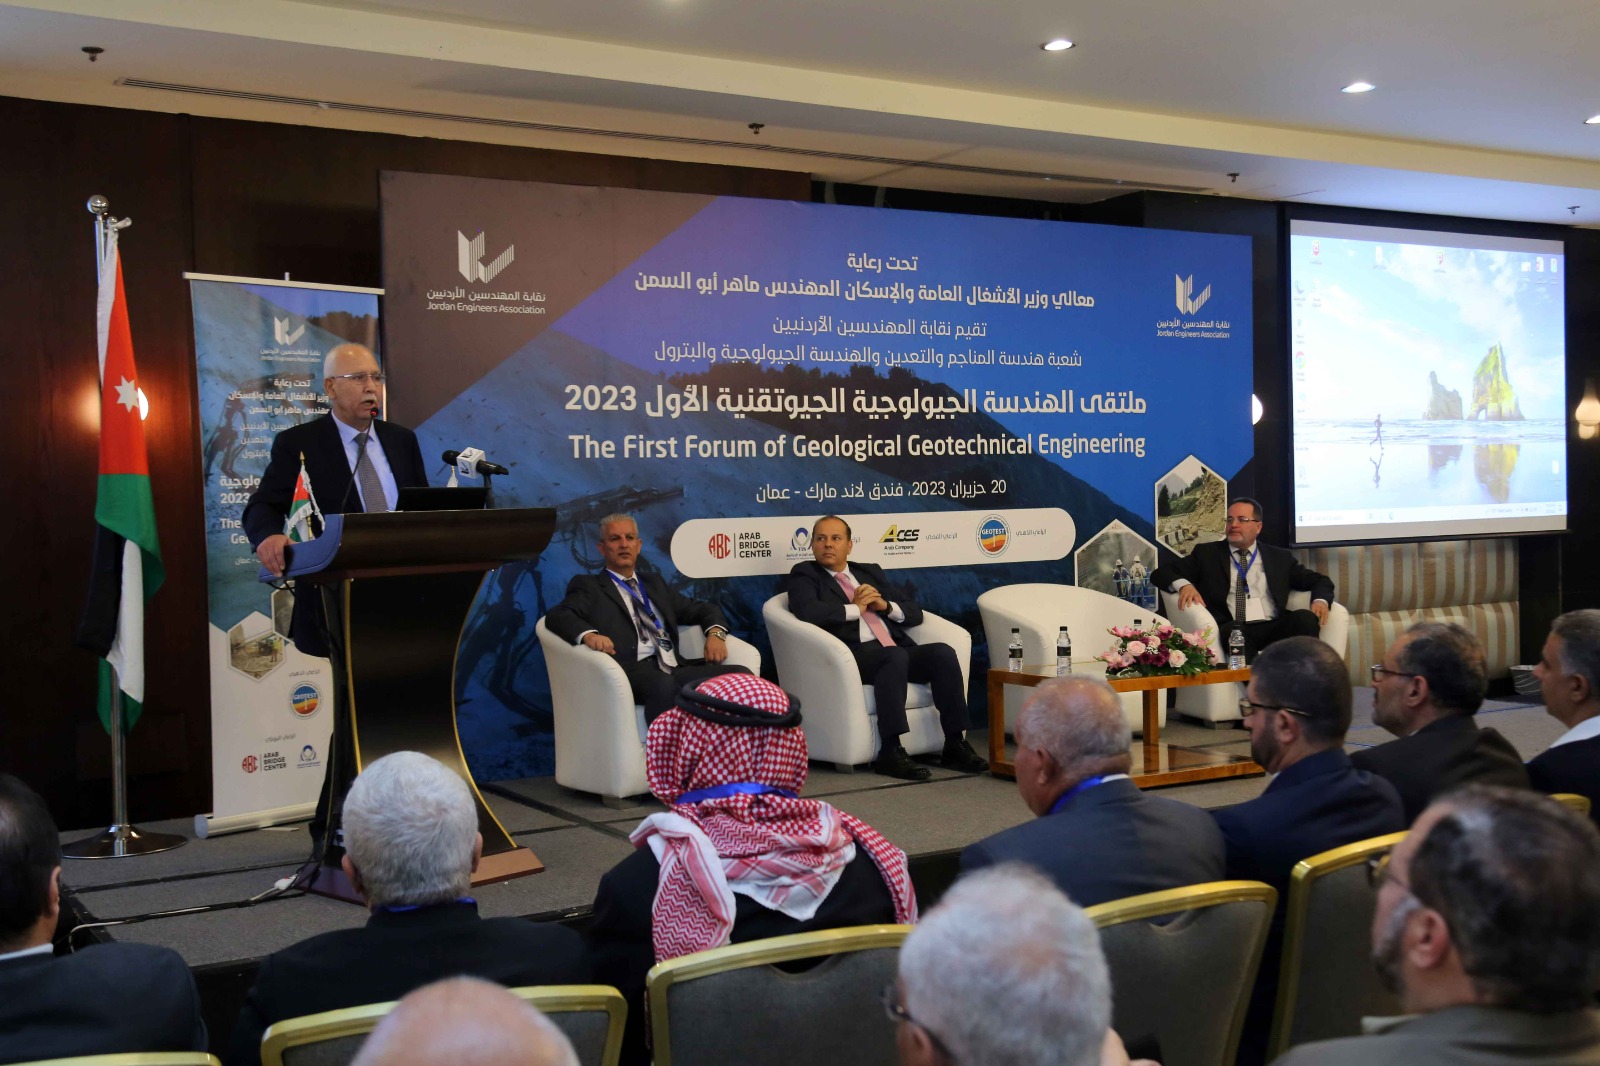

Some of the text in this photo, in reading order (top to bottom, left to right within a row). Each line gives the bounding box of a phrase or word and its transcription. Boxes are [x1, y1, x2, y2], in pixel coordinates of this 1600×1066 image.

[847, 252, 919, 273] تحت رعاية
[426, 286, 546, 303] نقابة المهندسين الأردنيين
[634, 271, 1095, 309] معالي وزير الأشغال العامة والإسكان المهندس ماهر أبو السمن
[426, 301, 546, 315] Jordan Engineers Association
[772, 315, 987, 340] تقيم نقابة المهندسين الأردنيين
[1215, 320, 1230, 329] نقابة
[1175, 330, 1200, 338] Engineers
[654, 340, 1082, 370] شعبة هندسة المناجم والتعدين والهندسة الجيولوجية والبترول
[273, 379, 311, 389] تحت رعاية
[564, 384, 1147, 420] ملتقى الهندسة الجيولوجية الجيوتقنية الأول 2023
[568, 432, 1146, 462] The First Forum of Geological Geotechnical Engineering
[219, 475, 261, 490] ولوجية
[840, 481, 865, 498] لاند
[950, 479, 986, 499] حزيران
[990, 479, 1007, 494] 20
[220, 493, 249, 503] 2023
[756, 483, 790, 502] عمان
[805, 482, 837, 502] مارك
[868, 483, 904, 501] فندق
[220, 518, 240, 528] The
[739, 532, 761, 540] ARAB
[739, 540, 770, 550] BRIDGE
[739, 550, 772, 559] CENTER
[264, 763, 286, 771] CENTER
